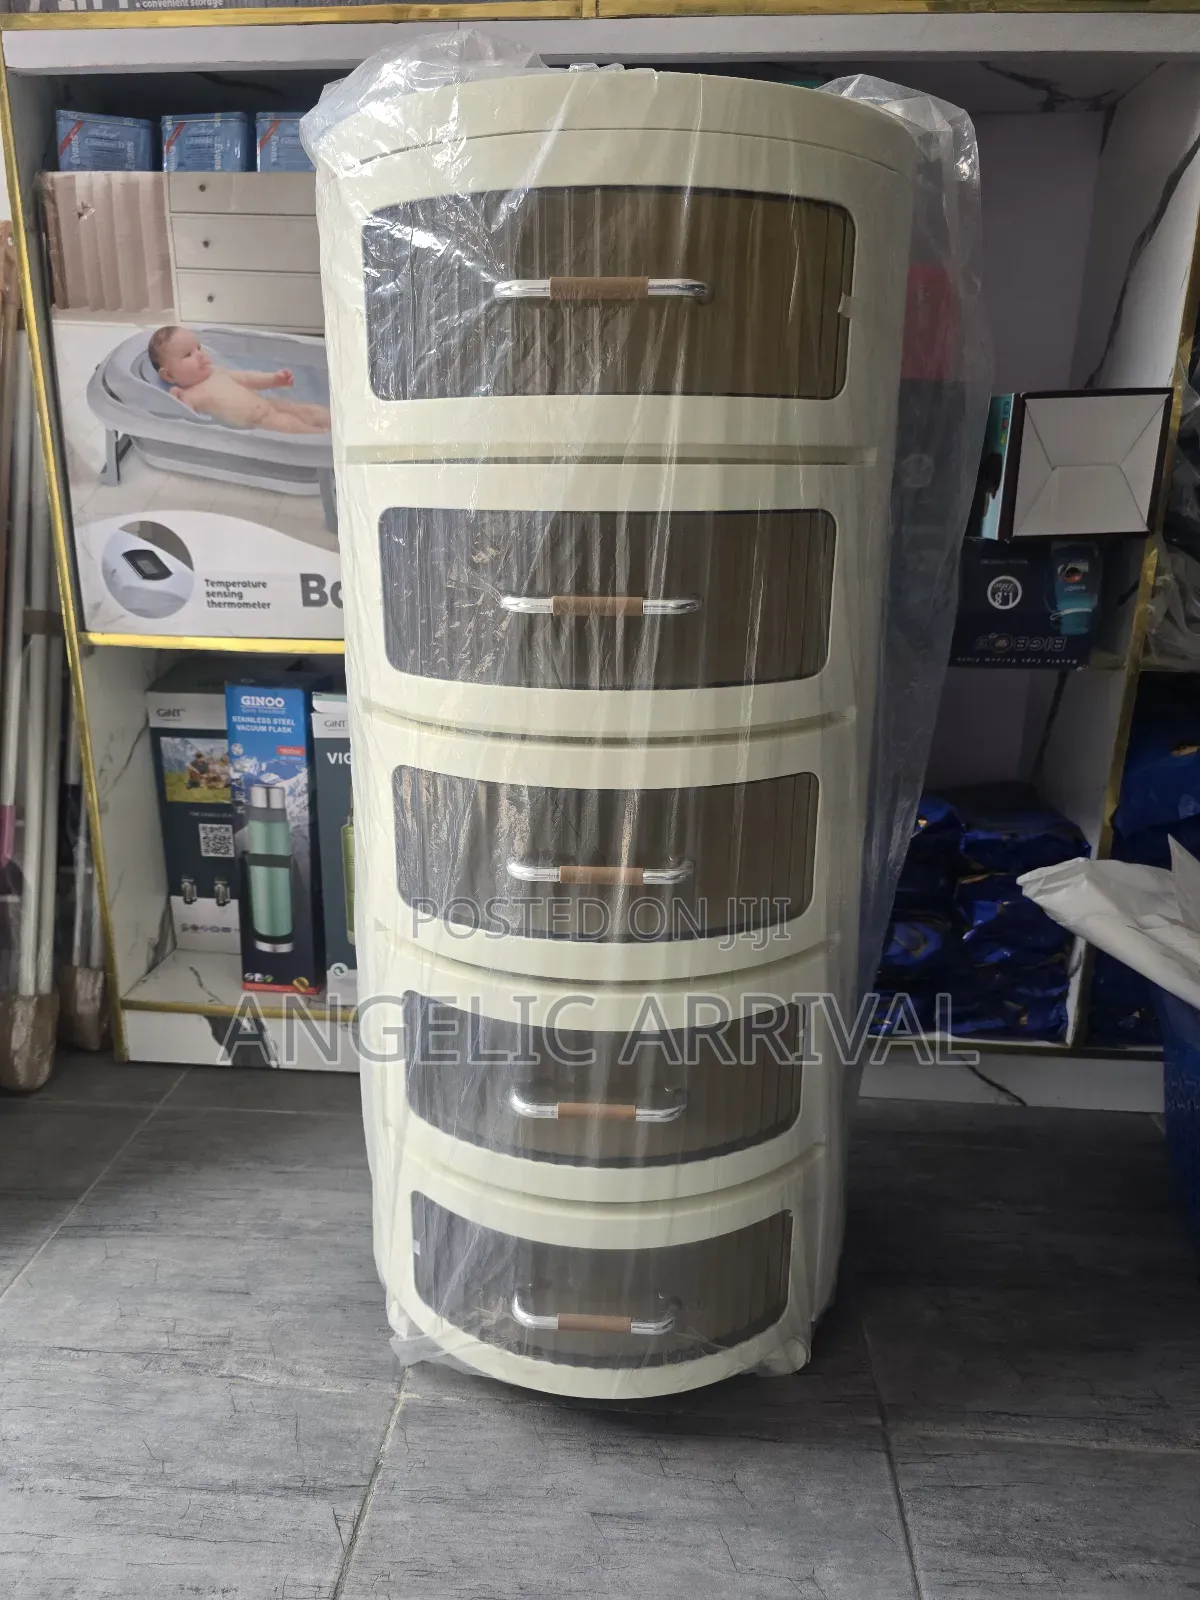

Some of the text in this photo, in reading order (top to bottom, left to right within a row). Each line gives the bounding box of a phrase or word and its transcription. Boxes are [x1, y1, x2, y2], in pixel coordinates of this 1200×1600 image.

[205, 579, 267, 591] Temperature
[206, 591, 243, 600] sensing
[207, 600, 271, 609] thermometer
[240, 695, 285, 708] GINOO
[232, 715, 296, 726] STAINLESS STEEL
[236, 724, 292, 734] VACUUM FLASK
